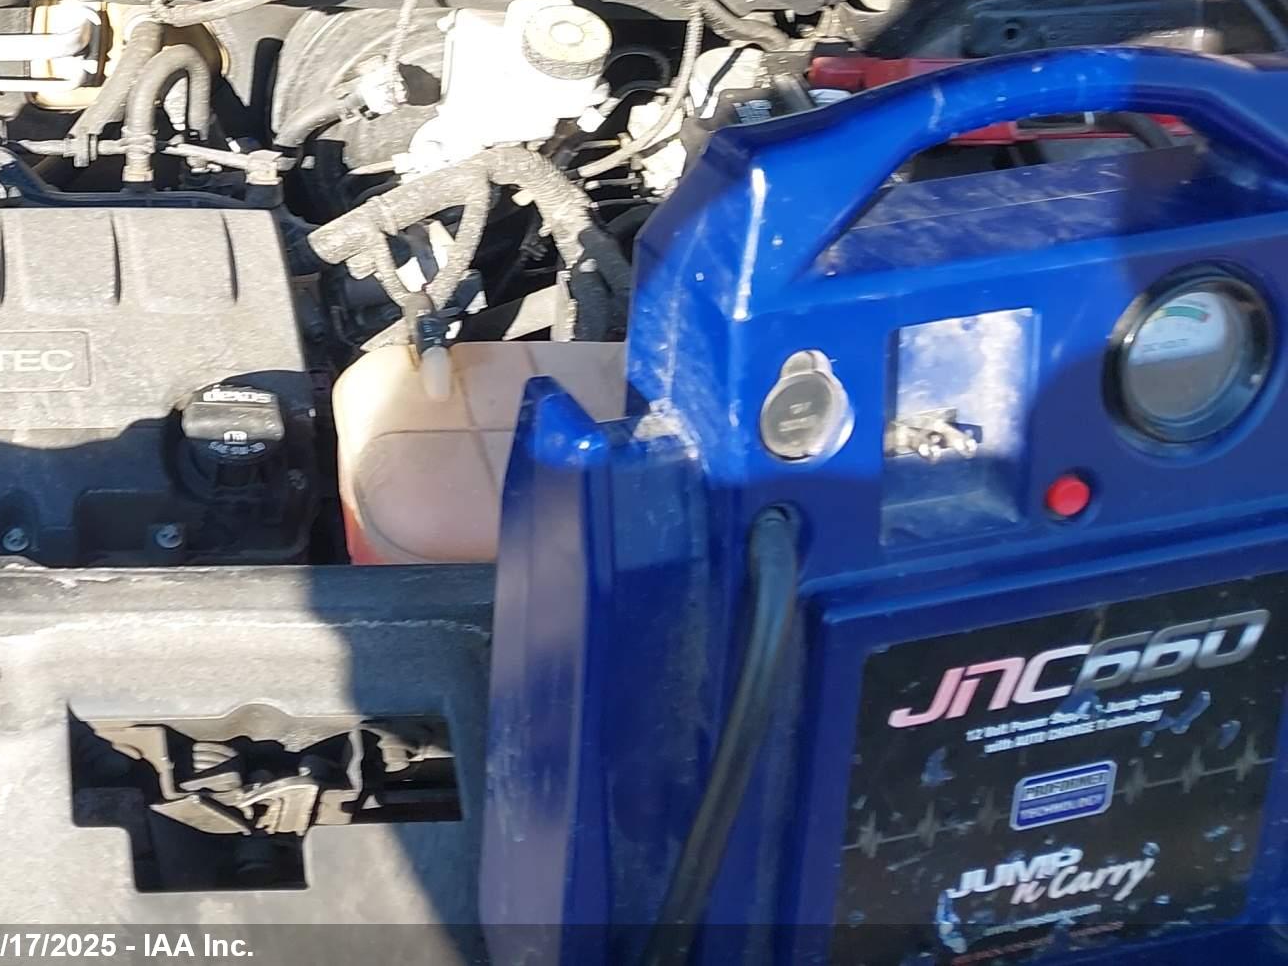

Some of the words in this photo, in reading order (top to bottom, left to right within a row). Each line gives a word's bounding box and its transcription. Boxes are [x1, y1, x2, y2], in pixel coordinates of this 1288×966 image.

[888, 609, 1270, 729] JNC660
[946, 848, 1084, 899] JUMP
[1047, 858, 1156, 901] Carry
